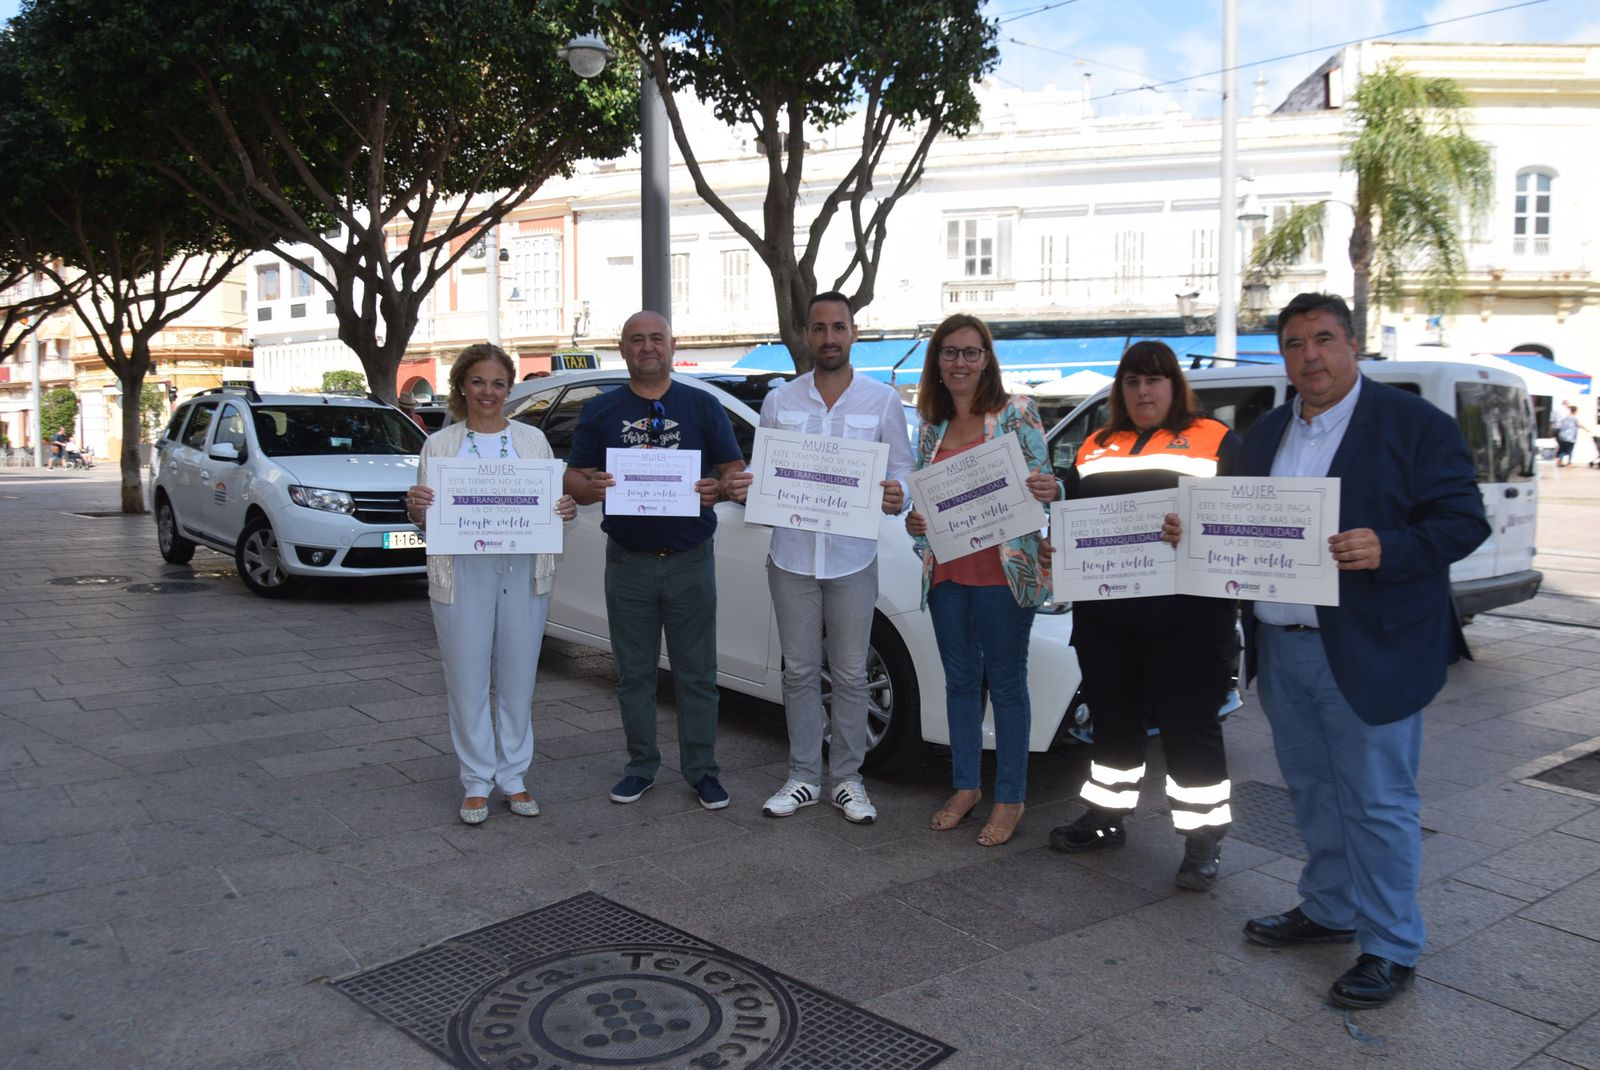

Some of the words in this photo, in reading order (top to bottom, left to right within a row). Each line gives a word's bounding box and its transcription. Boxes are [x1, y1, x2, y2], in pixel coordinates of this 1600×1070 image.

[564, 356, 588, 368] TAXI
[660, 431, 681, 446] good
[802, 440, 839, 454] MUJER
[791, 452, 819, 461] TIEMPO
[846, 459, 866, 467] PAGA
[946, 456, 978, 476] MUJER
[478, 464, 515, 475] MUJER
[770, 459, 789, 467] PERO
[813, 464, 829, 472] QUE
[849, 469, 866, 477] VALE
[927, 485, 940, 494] ESTE
[942, 474, 966, 488] TIEMPO
[967, 470, 978, 478] NO
[987, 459, 1005, 470] PAGA
[627, 488, 650, 497] tiempo
[653, 489, 675, 497] violeta
[816, 483, 840, 492] TODAS
[929, 493, 945, 503] PERO
[964, 480, 978, 490] QUE
[994, 468, 1009, 477] VALE
[1231, 484, 1276, 500] MUJER
[778, 489, 810, 504] tiempo
[815, 495, 848, 508] violeta
[975, 493, 996, 505] TODAS
[1100, 500, 1137, 514] MUJER
[1198, 502, 1215, 510] ESTE
[1220, 502, 1253, 511] TIEMPO
[1256, 503, 1270, 511] NO
[1274, 504, 1284, 512] SE
[1287, 504, 1311, 512] PAGA
[458, 516, 492, 528] tiempo
[497, 516, 529, 527] violeta
[948, 512, 978, 532] tiempo
[981, 502, 1008, 520] violeta
[1090, 517, 1118, 526] TIEMPO
[1196, 513, 1217, 522] PERO
[1234, 514, 1243, 522] EL
[1247, 515, 1266, 524] QUE
[1291, 516, 1312, 525] VALE
[1070, 530, 1088, 538] PERO
[1113, 526, 1129, 534] QUE
[394, 534, 424, 546] 1166
[1224, 538, 1233, 546] LA
[1237, 538, 1248, 547] DE
[1253, 539, 1282, 548] TODAS
[1120, 544, 1144, 553] TODAS
[1082, 560, 1116, 573] tiempo
[1120, 555, 1154, 569] violeta
[1208, 549, 1248, 567] tiempo
[1253, 552, 1292, 568] violeta
[620, 952, 773, 1068] Telefónica
